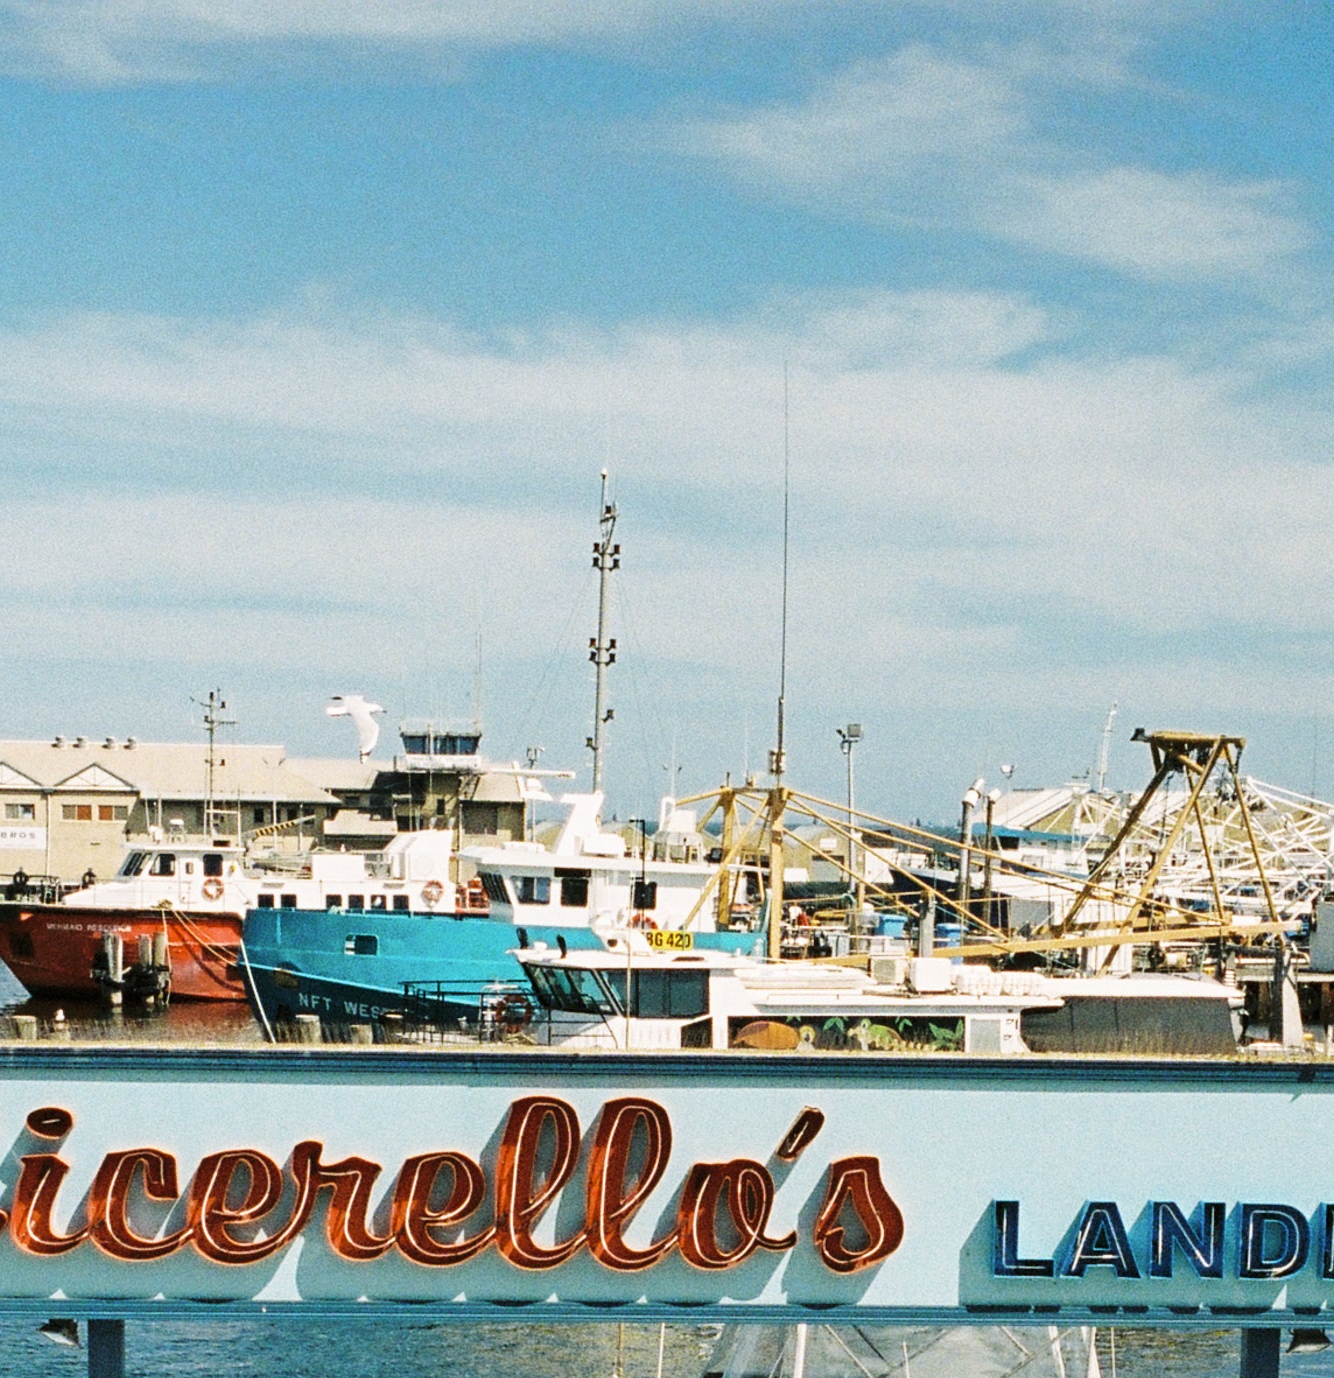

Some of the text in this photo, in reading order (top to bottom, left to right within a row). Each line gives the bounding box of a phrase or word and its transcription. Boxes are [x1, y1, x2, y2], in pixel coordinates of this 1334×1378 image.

[0, 831, 36, 839] BROS
[666, 933, 691, 948] 420
[298, 992, 391, 1019] NFT WES
